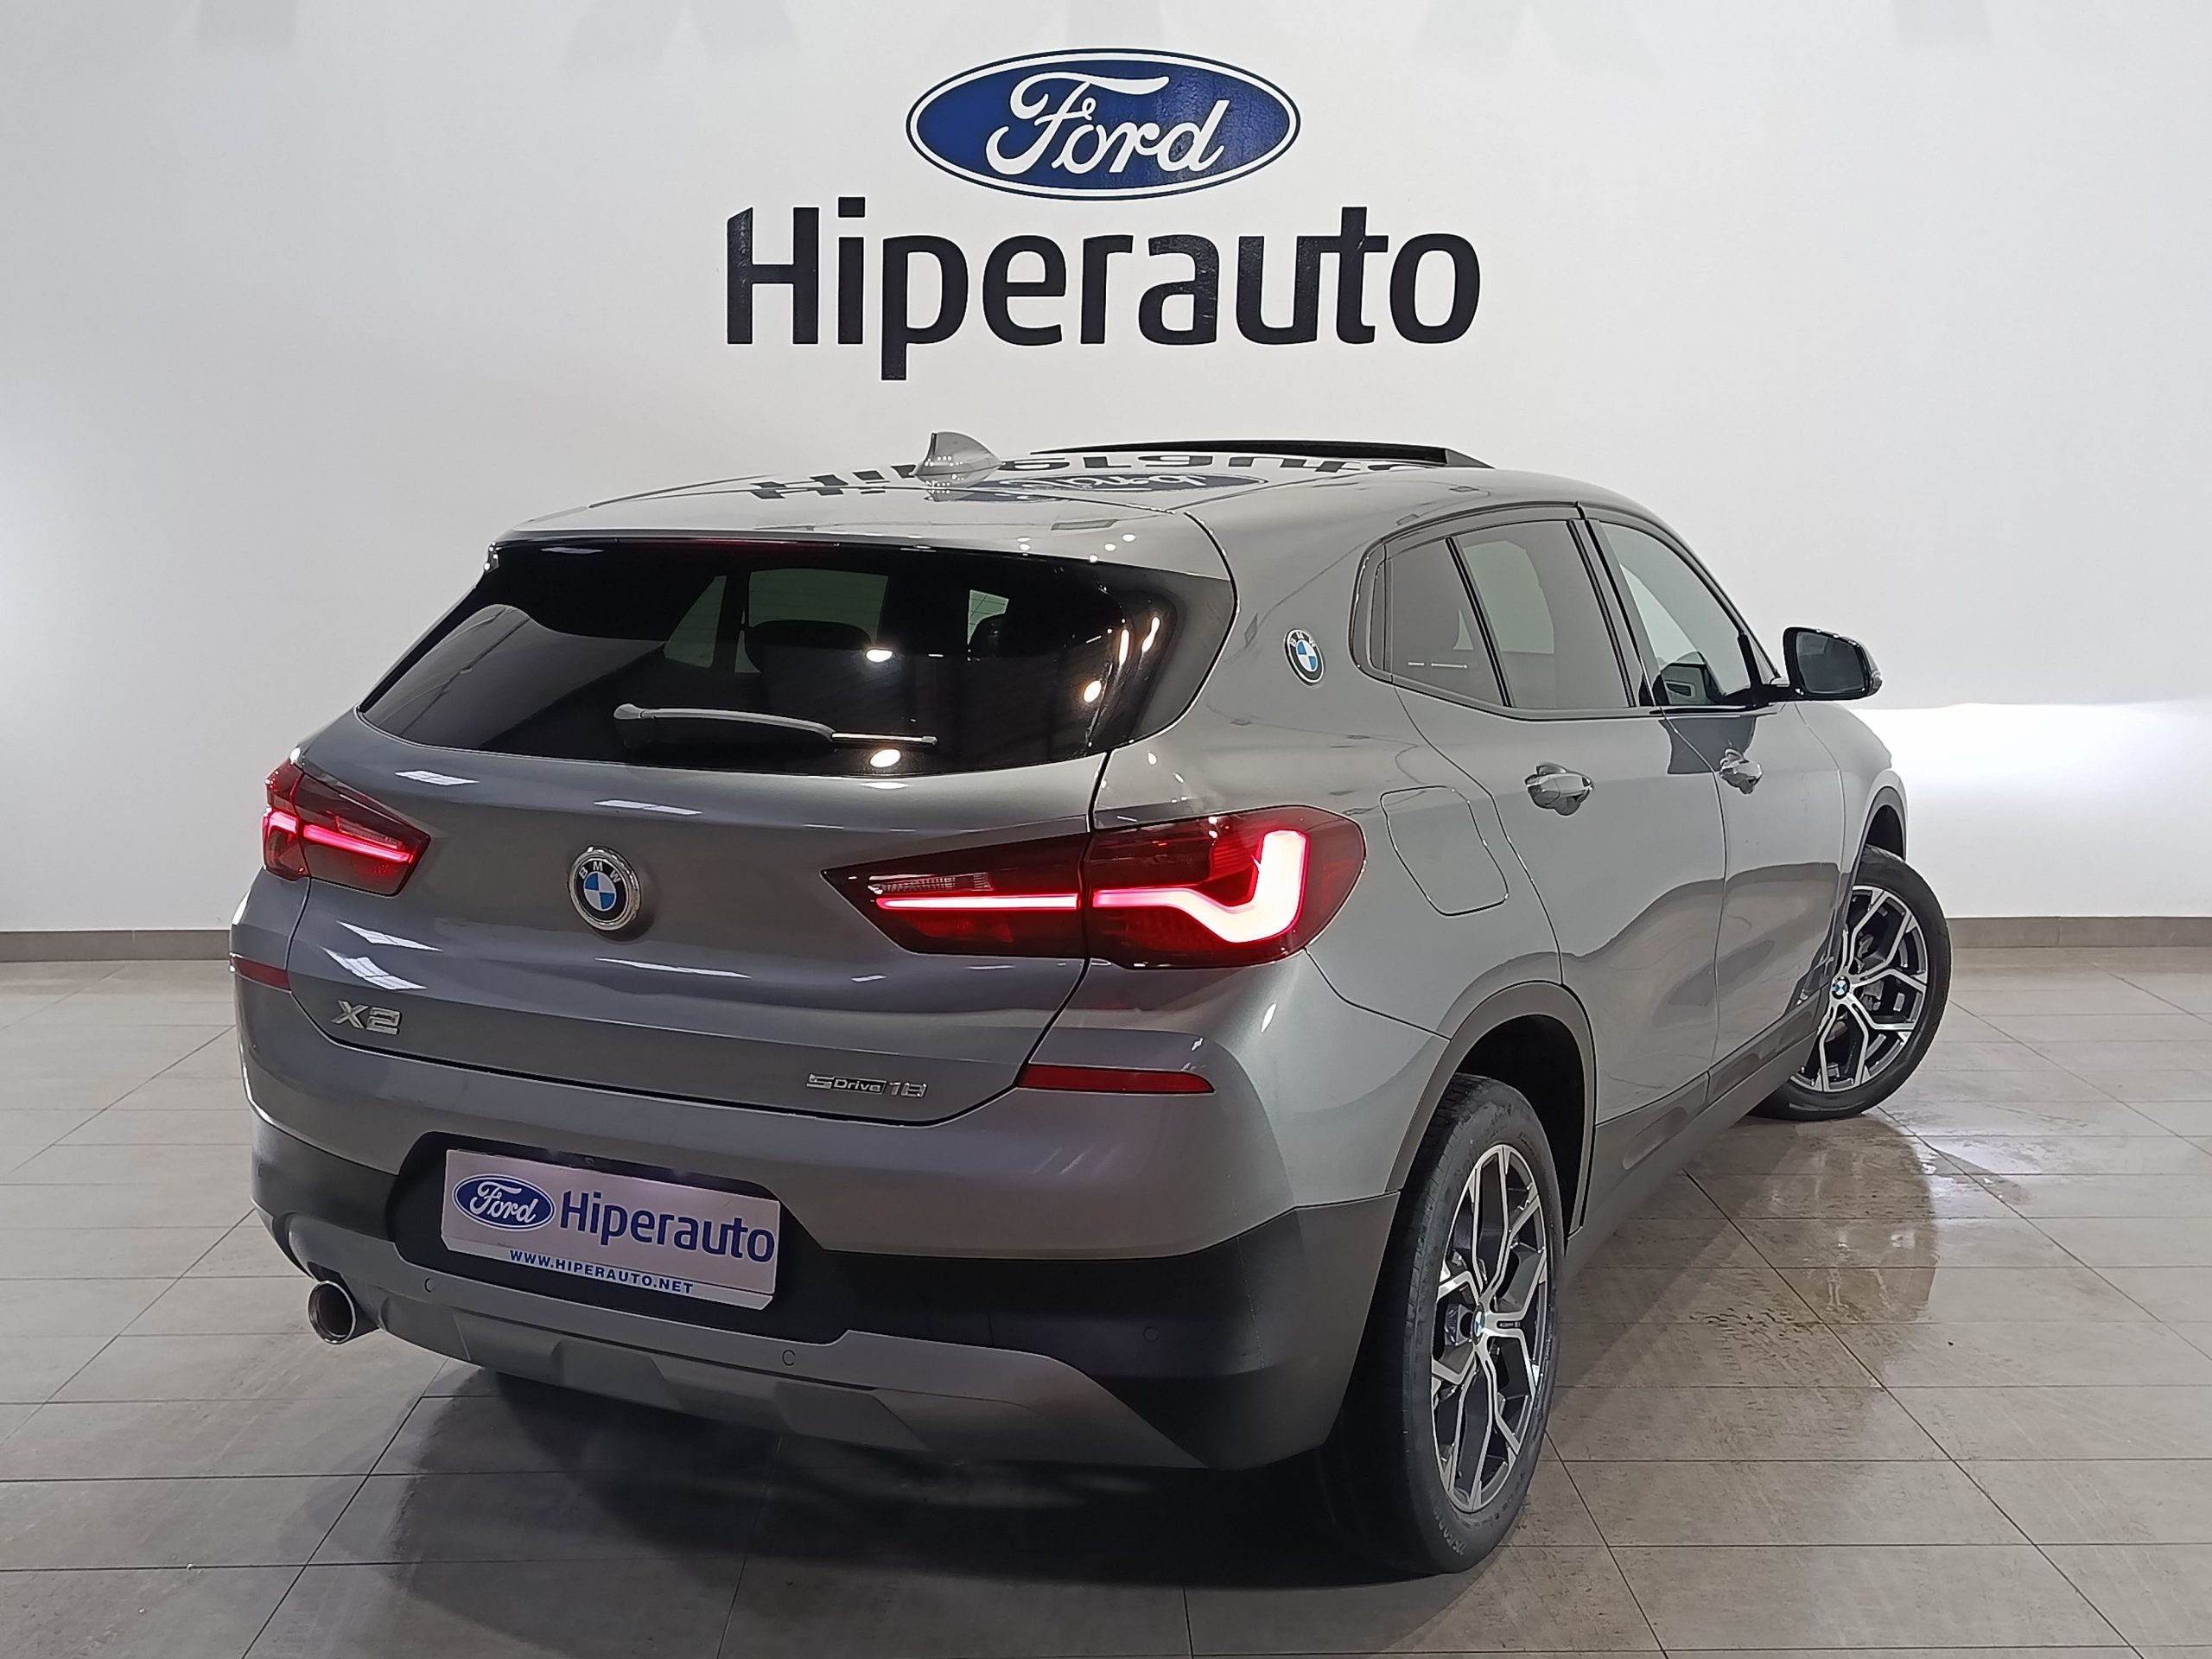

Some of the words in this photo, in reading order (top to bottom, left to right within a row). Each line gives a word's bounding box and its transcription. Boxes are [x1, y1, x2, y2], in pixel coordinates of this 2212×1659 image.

[986, 73, 1229, 175] Ford
[726, 196, 1481, 381] Hiperauto
[578, 861, 621, 883] BMW
[331, 1000, 401, 1036] X2
[469, 1180, 539, 1224] Ford
[559, 1190, 775, 1263] Hiperauto
[510, 1249, 694, 1294] WWW.HIPERAUTO.NET
